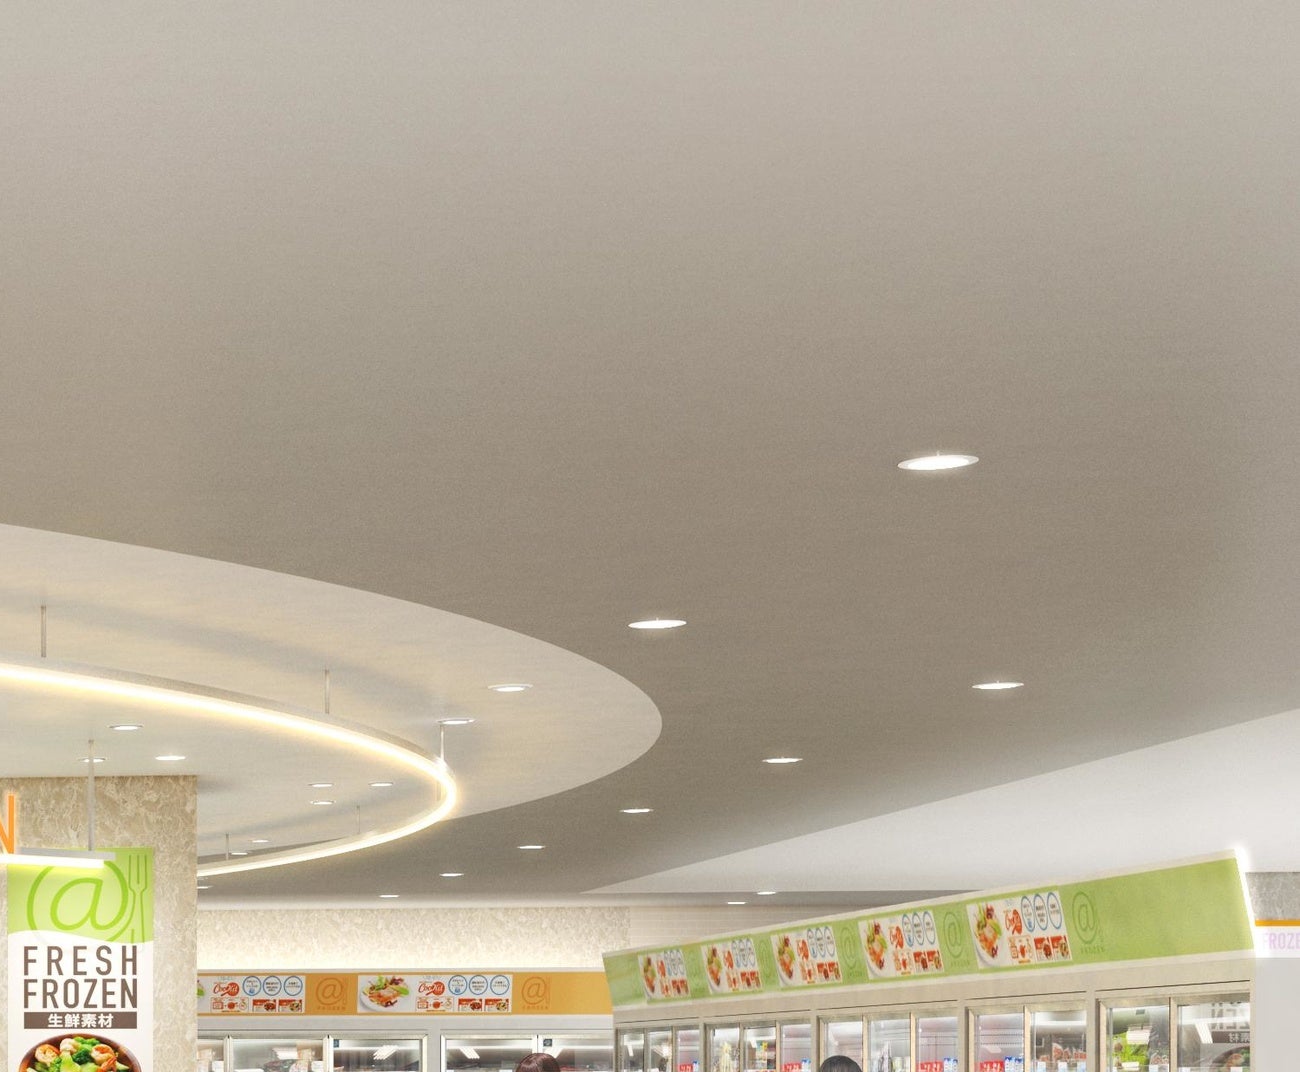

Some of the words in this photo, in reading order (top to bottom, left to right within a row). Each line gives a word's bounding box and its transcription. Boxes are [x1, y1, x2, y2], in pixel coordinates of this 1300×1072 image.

[1263, 933, 1300, 950] FROZE
[23, 945, 137, 975] FRESH
[23, 978, 137, 1009] FROZEN
[47, 1013, 114, 1028] 生鮮素材
